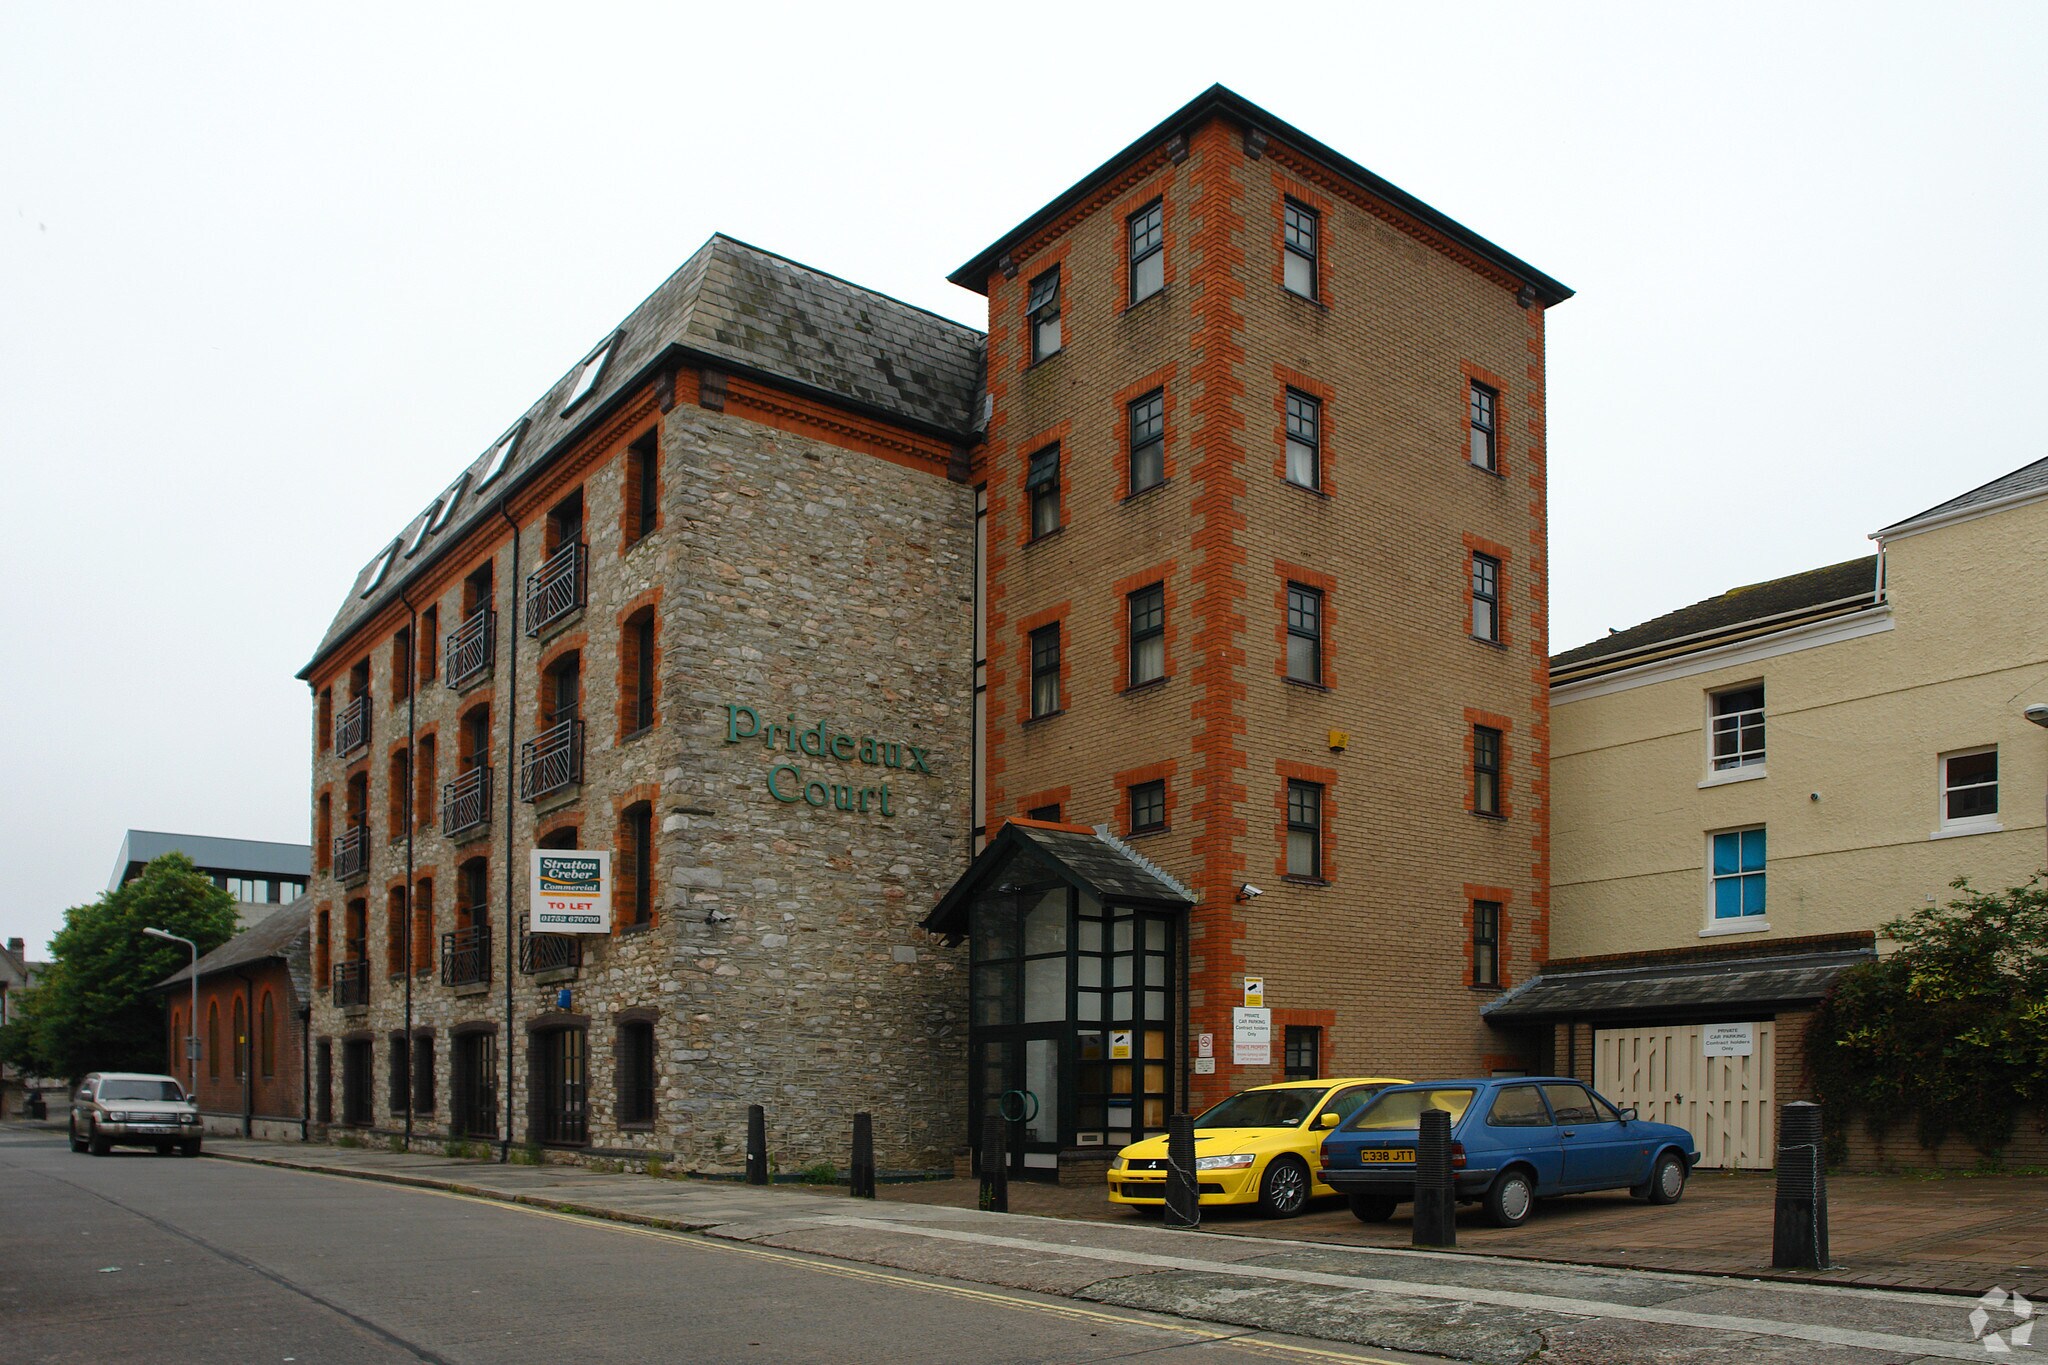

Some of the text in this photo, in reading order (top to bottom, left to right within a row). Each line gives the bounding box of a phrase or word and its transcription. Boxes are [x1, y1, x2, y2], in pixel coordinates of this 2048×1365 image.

[724, 703, 930, 773] Prideaux
[767, 764, 896, 817] Court
[543, 859, 597, 870] Stratton
[548, 869, 593, 879] Creber
[543, 883, 597, 891] Commercial
[569, 902, 592, 910] LET
[1362, 1151, 1413, 1161] C338 JTT
